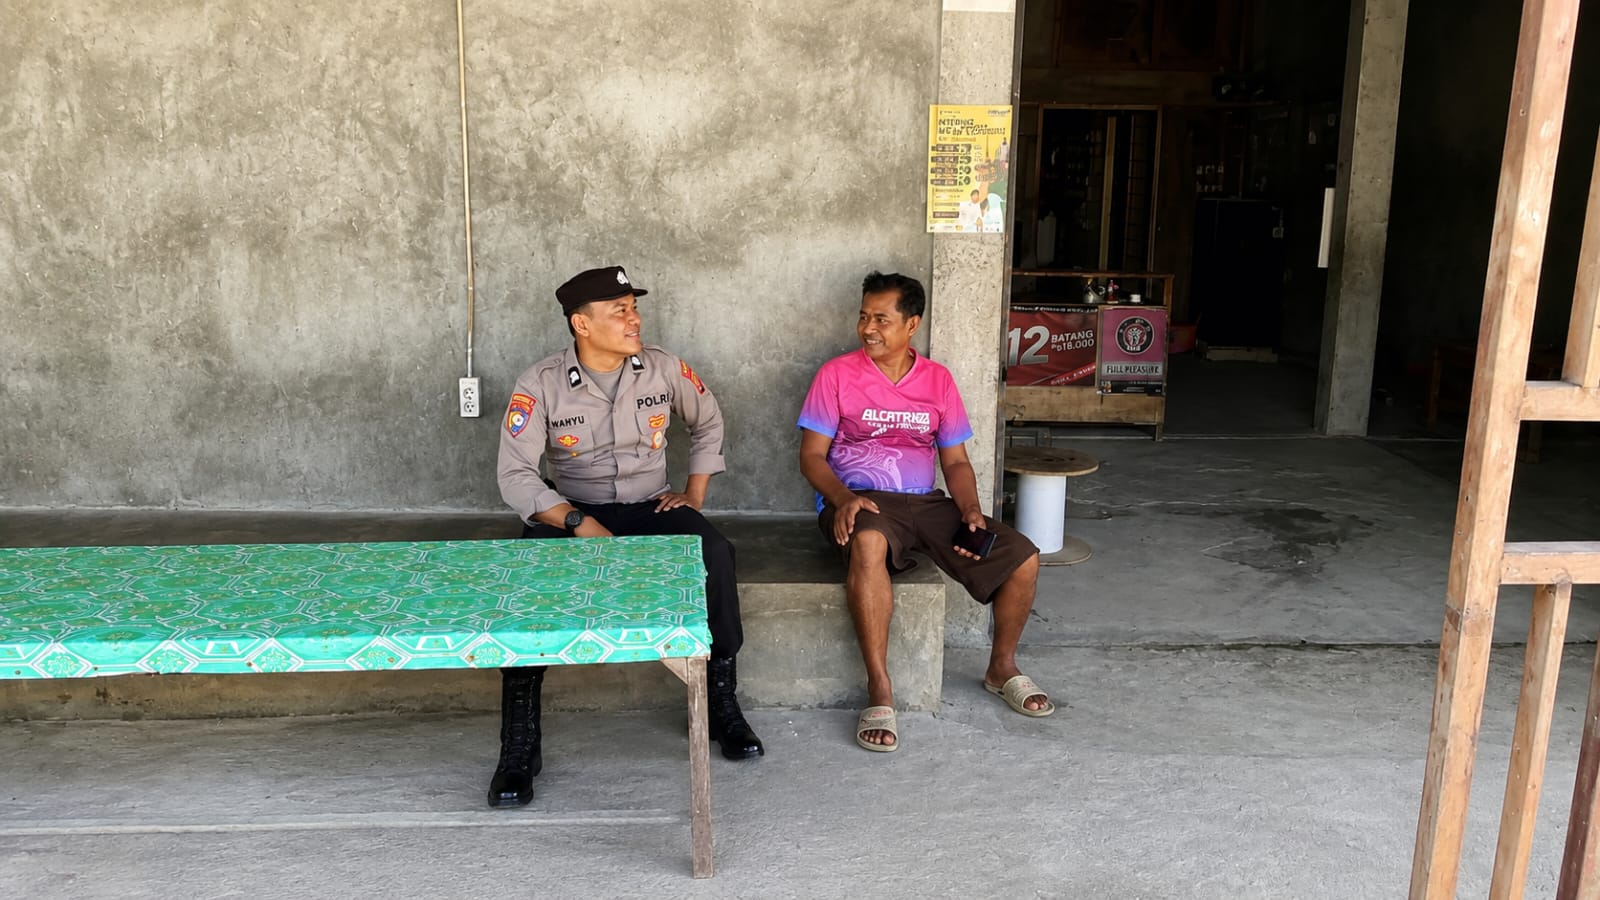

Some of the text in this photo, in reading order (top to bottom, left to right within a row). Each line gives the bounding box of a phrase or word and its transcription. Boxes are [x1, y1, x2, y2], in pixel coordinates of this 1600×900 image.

[1051, 330, 1094, 343] BATANG
[1008, 325, 1050, 366] 12
[636, 392, 670, 409] POLRI
[551, 415, 585, 428] WAHYU
